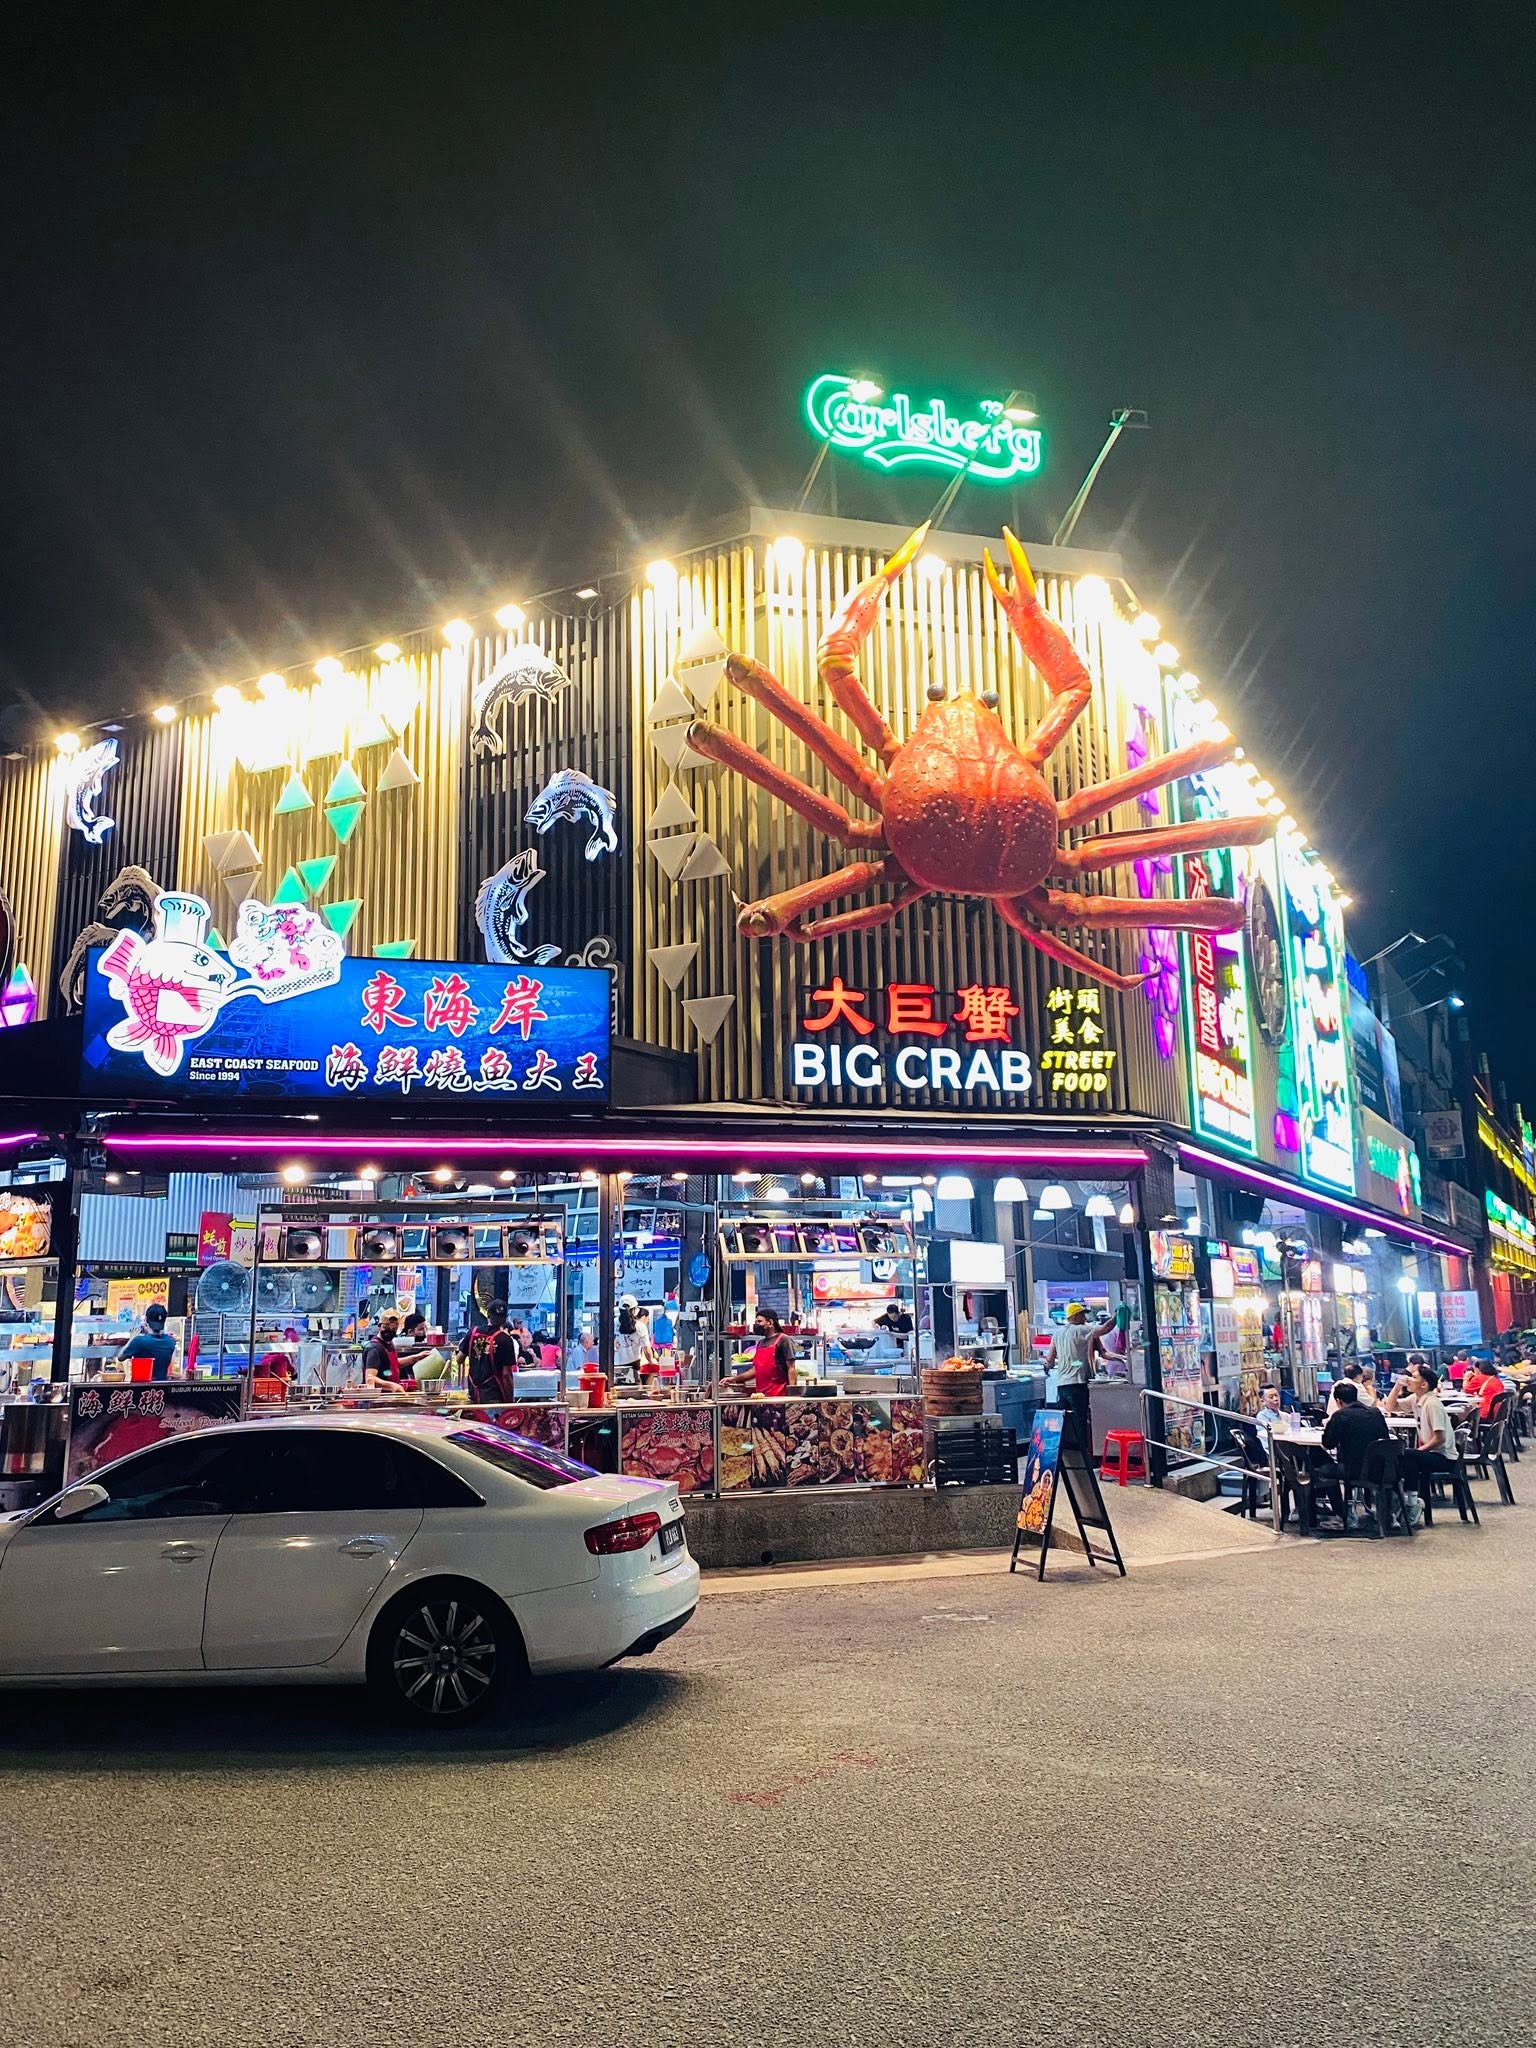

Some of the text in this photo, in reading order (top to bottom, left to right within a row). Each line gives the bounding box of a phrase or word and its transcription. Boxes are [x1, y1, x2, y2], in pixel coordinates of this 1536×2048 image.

[807, 374, 1042, 478] Carlsberg
[360, 970, 552, 1041] 東海岸
[803, 976, 1020, 1043] 大巨蟹
[1046, 986, 1101, 1015] 街頭
[1050, 1016, 1105, 1045] 美食
[190, 1058, 319, 1072] EAST COAST SEAFOOD
[325, 1042, 605, 1095] 海鮮燒魚大王
[793, 1043, 1033, 1092] BIG CRAB
[1041, 1050, 1116, 1071] STREET
[189, 1071, 241, 1081] Since 1994
[1052, 1072, 1108, 1093] FOOD
[77, 1389, 165, 1419] 海鮮粥
